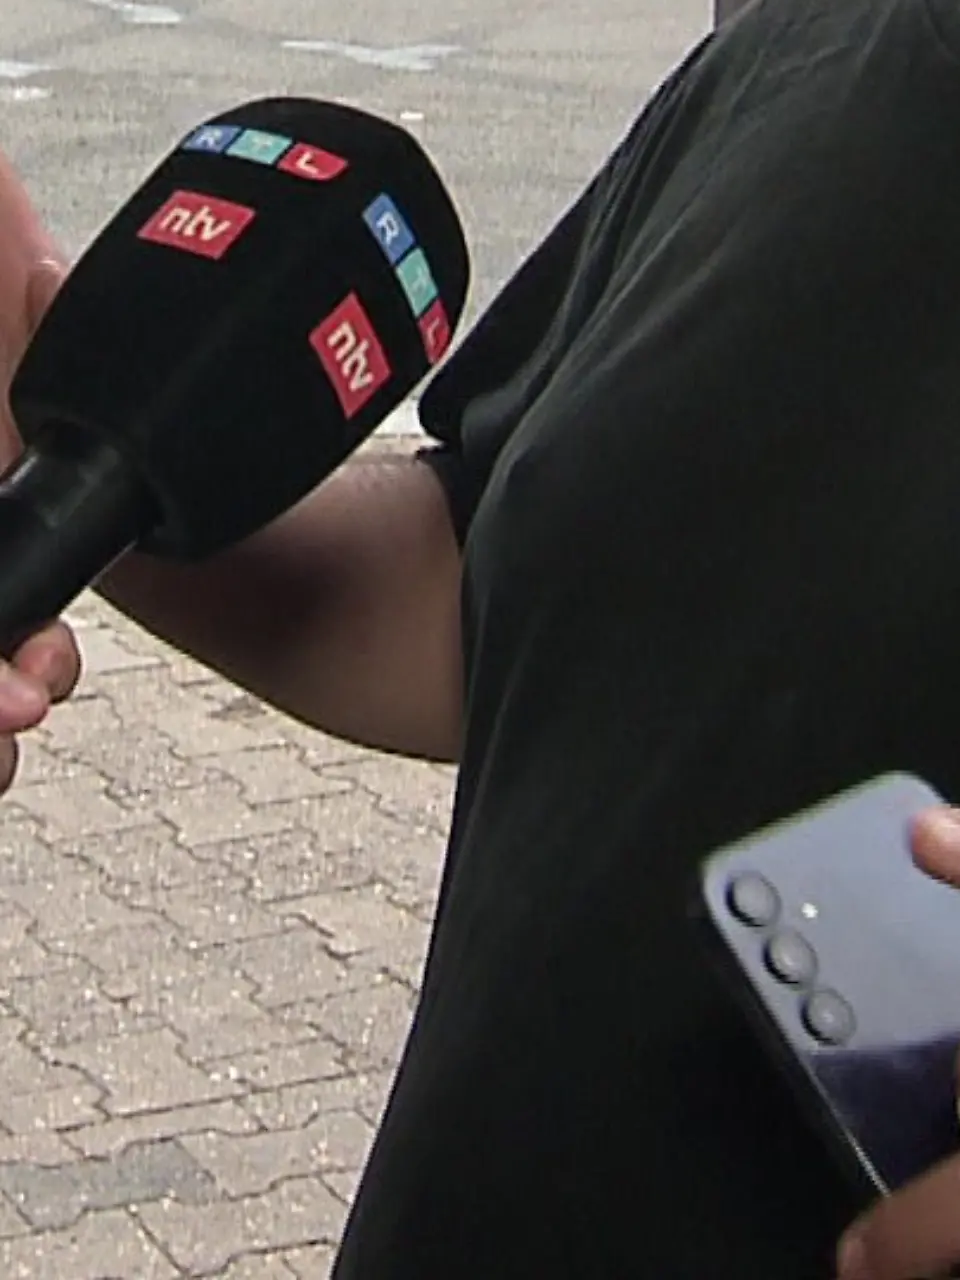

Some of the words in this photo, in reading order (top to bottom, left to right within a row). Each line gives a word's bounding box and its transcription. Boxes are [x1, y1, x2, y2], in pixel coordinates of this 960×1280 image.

[200, 127, 321, 176] RTL
[160, 205, 231, 241] ntv
[326, 322, 373, 391] ntv
